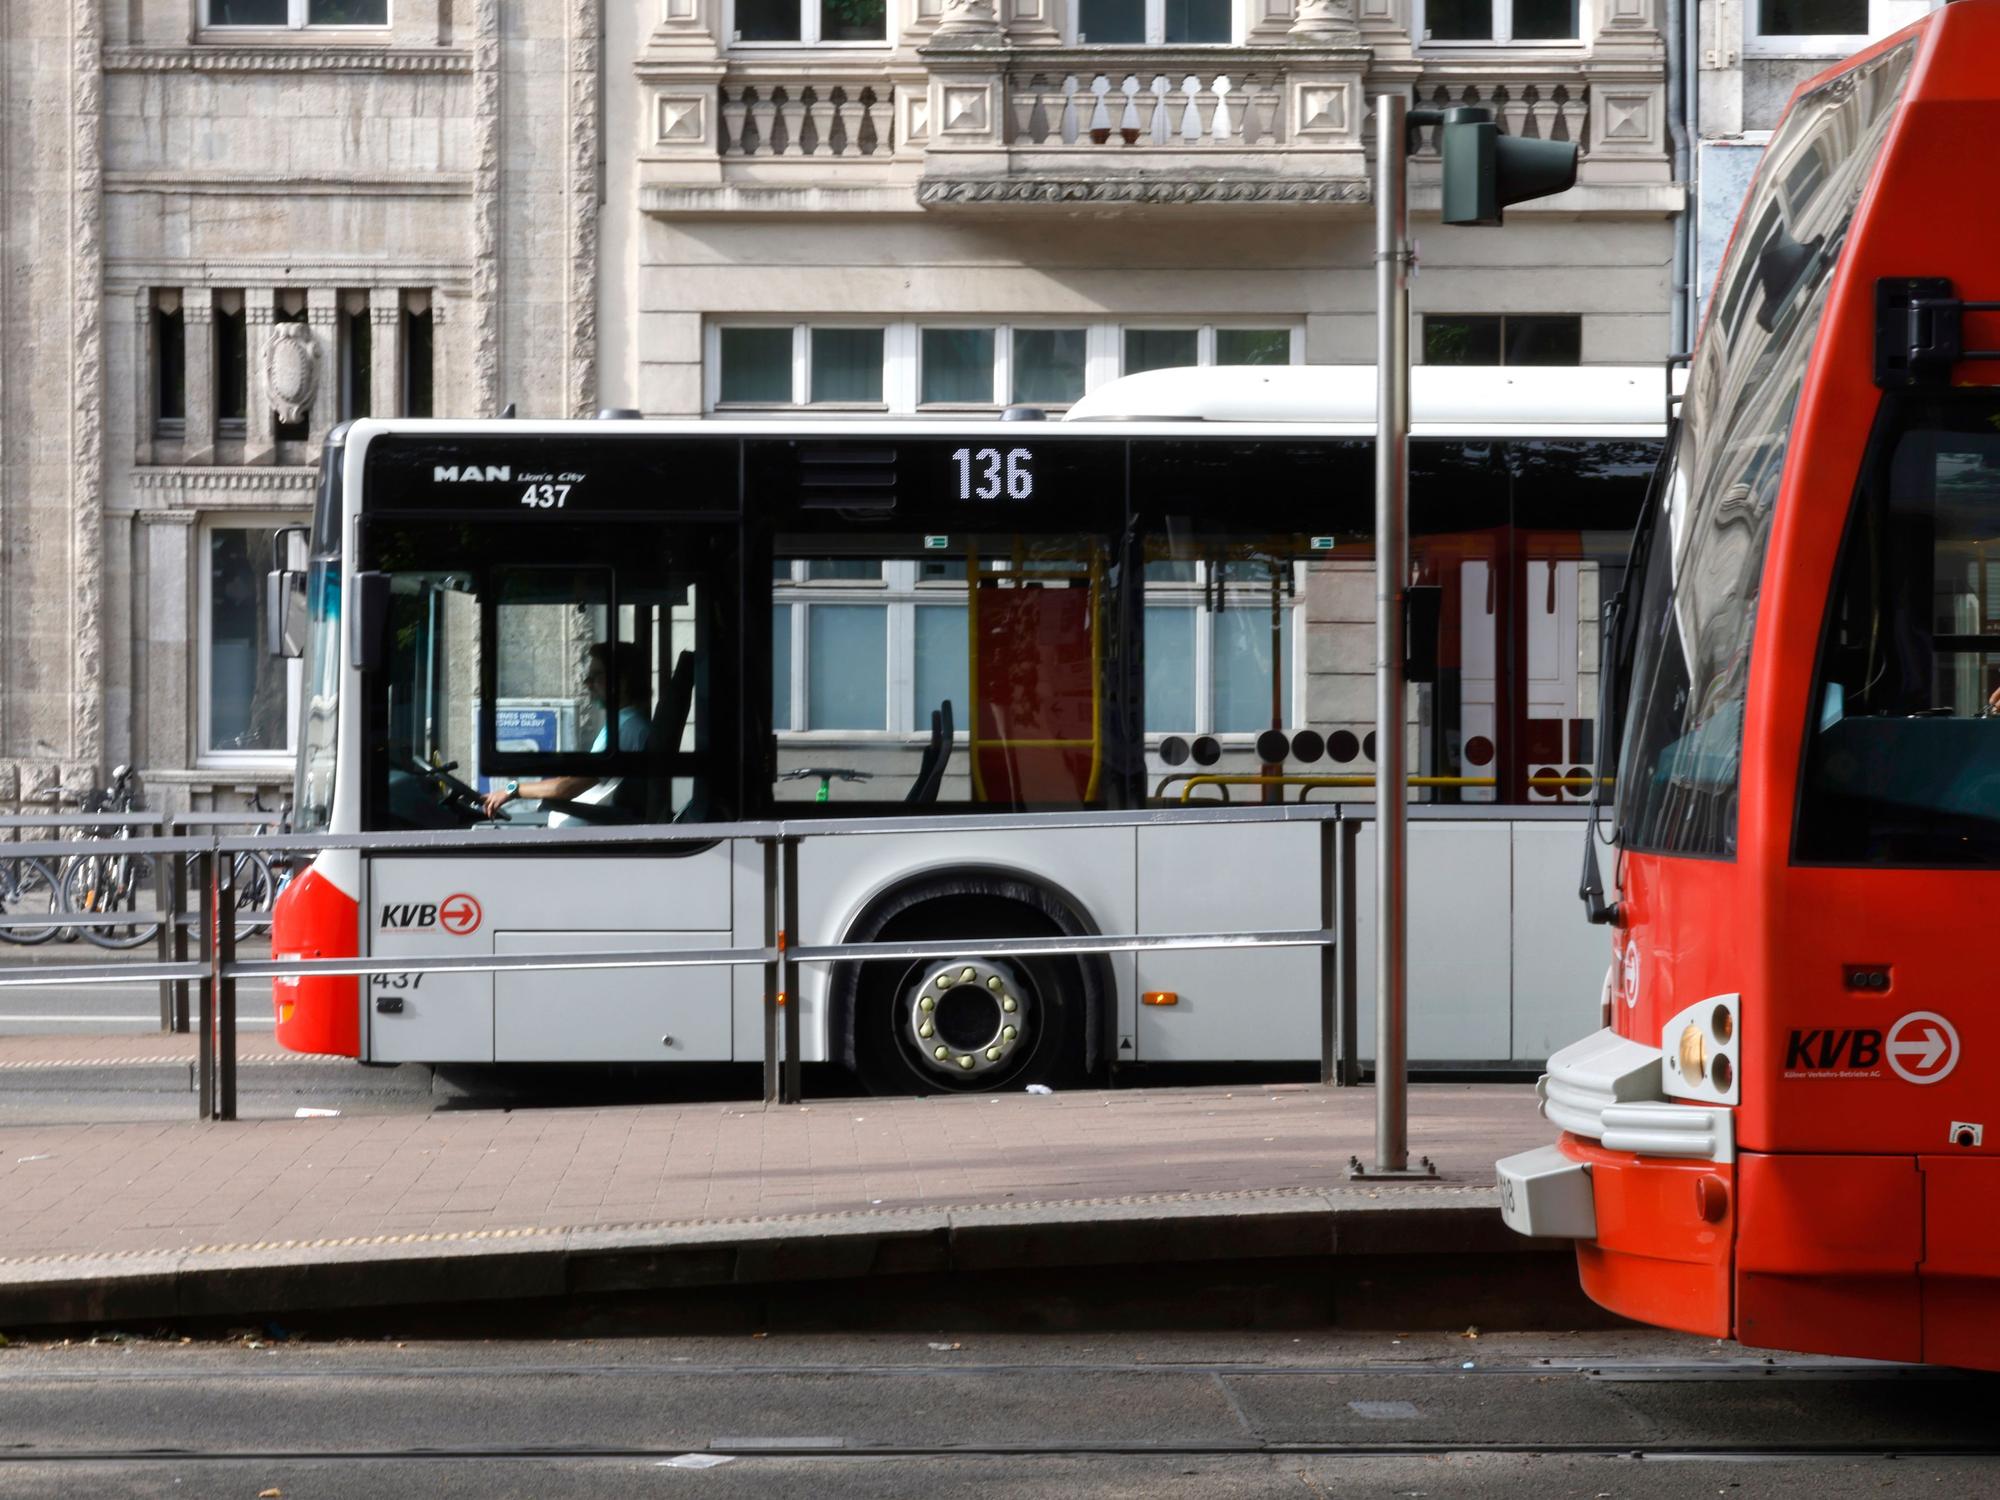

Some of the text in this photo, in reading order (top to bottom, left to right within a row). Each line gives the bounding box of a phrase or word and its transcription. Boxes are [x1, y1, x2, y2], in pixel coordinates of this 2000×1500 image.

[433, 465, 587, 483] MAN Lion's City
[951, 448, 1033, 500] 136
[521, 484, 572, 509] 437
[380, 904, 438, 928] KVB
[1785, 1029, 1883, 1070] KVB
[1869, 1070, 1881, 1078] AG
